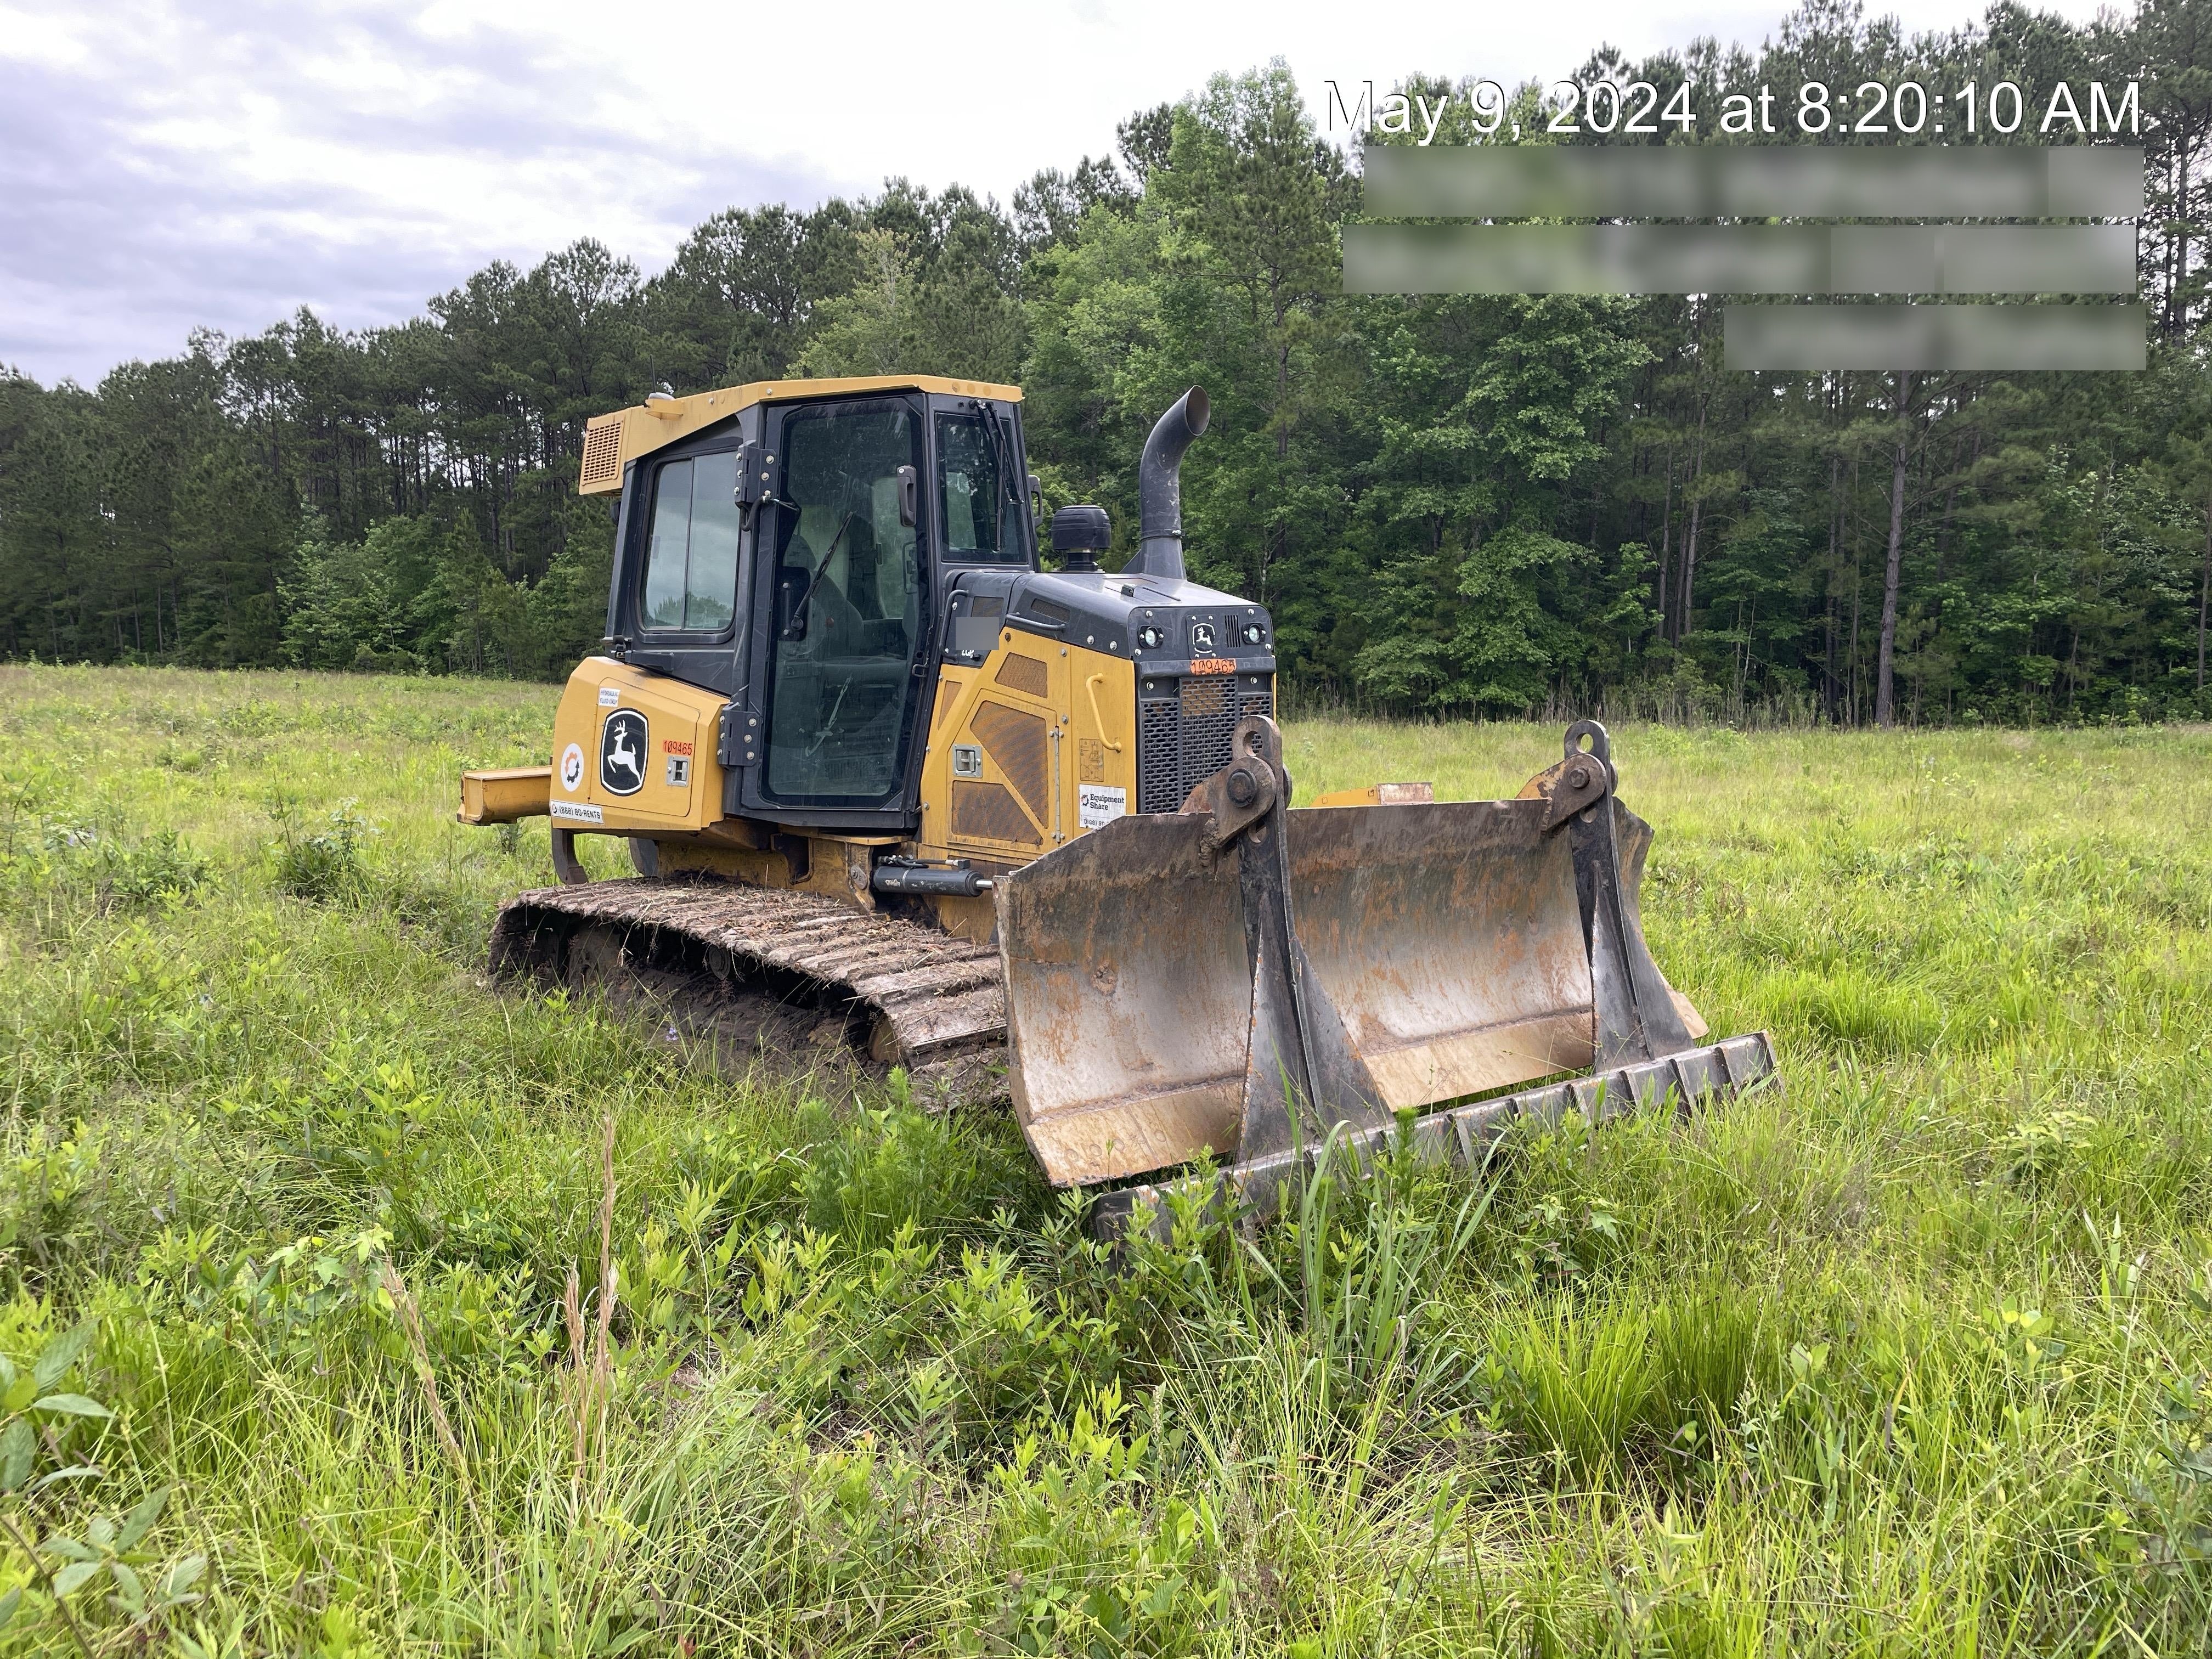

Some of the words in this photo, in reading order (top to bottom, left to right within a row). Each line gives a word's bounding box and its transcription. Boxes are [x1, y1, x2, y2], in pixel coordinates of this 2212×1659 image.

[1192, 660, 1235, 673] 109465
[664, 740, 692, 755] 109465
[1090, 794, 1125, 804] Equipment
[560, 805, 573, 816] (888)
